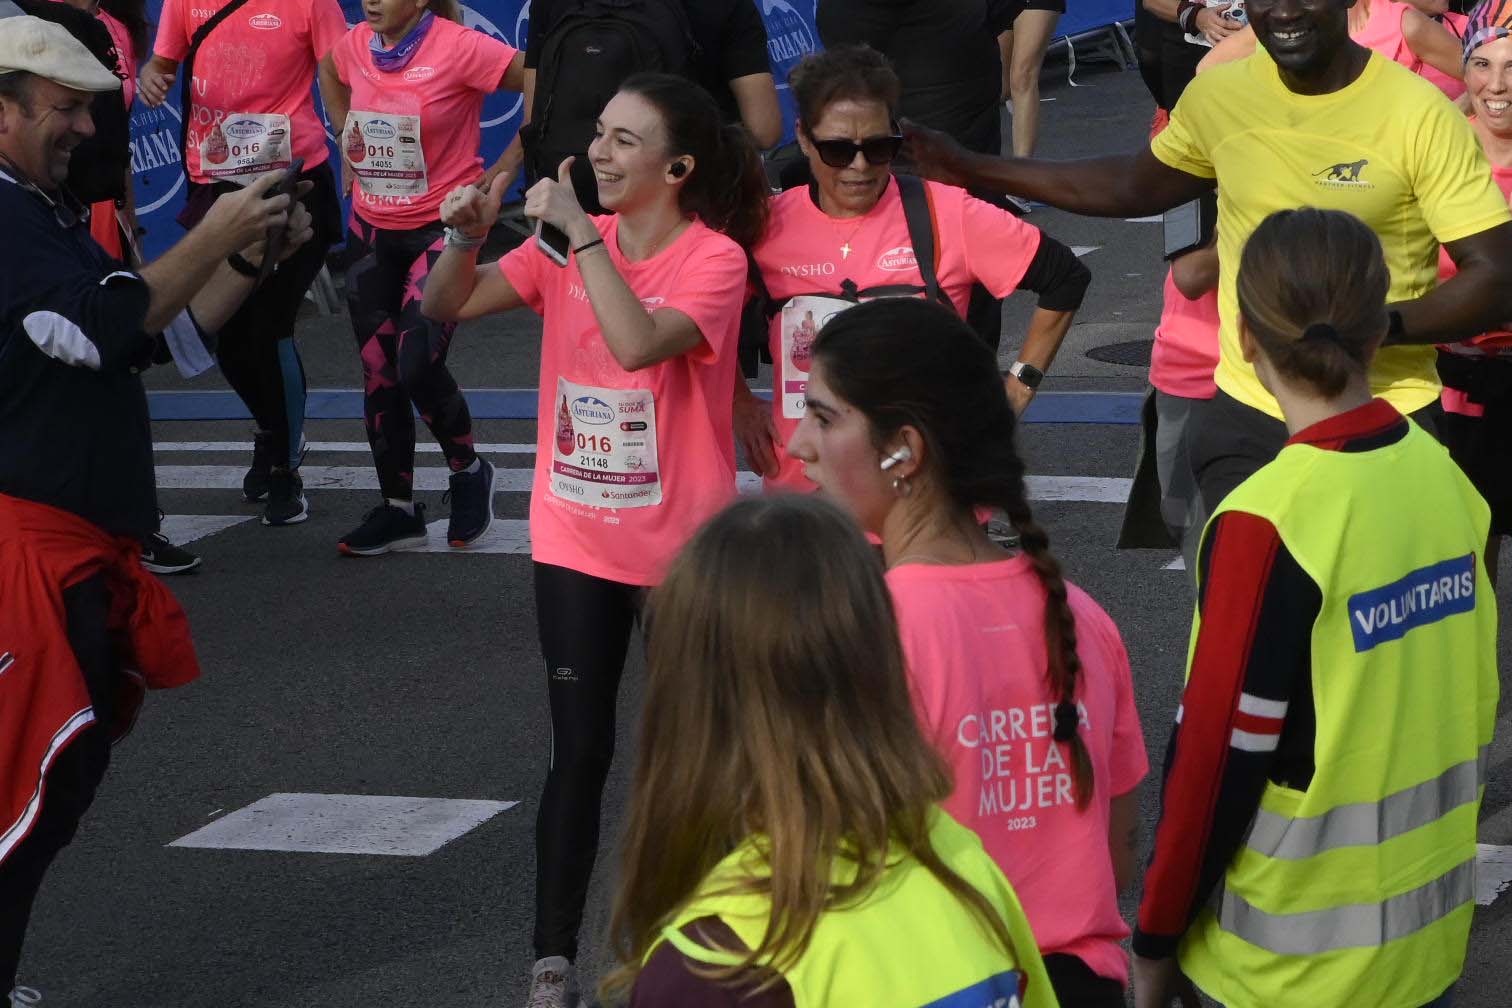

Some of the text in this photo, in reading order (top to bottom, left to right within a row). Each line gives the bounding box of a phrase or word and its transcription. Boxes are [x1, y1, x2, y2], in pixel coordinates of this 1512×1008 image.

[230, 125, 263, 136] ASTURIANA
[366, 127, 395, 136] ASTURIANA
[231, 142, 260, 157] 016
[368, 145, 394, 158] 016
[371, 160, 393, 169] 14055
[574, 405, 612, 421] ASTURIANA
[619, 406, 646, 414] SUMA
[576, 432, 612, 453] 016
[580, 456, 609, 469] 21148
[560, 466, 583, 477] CARRERA
[593, 472, 601, 480] LA
[602, 473, 626, 482] MUJER
[559, 481, 584, 495] OYSHO
[610, 490, 652, 500] Santander
[1357, 571, 1473, 635] VOLUNTARIS
[982, 737, 1066, 780] DE LA
[979, 775, 1074, 817] MUJER
[1007, 816, 1036, 831] 2023
